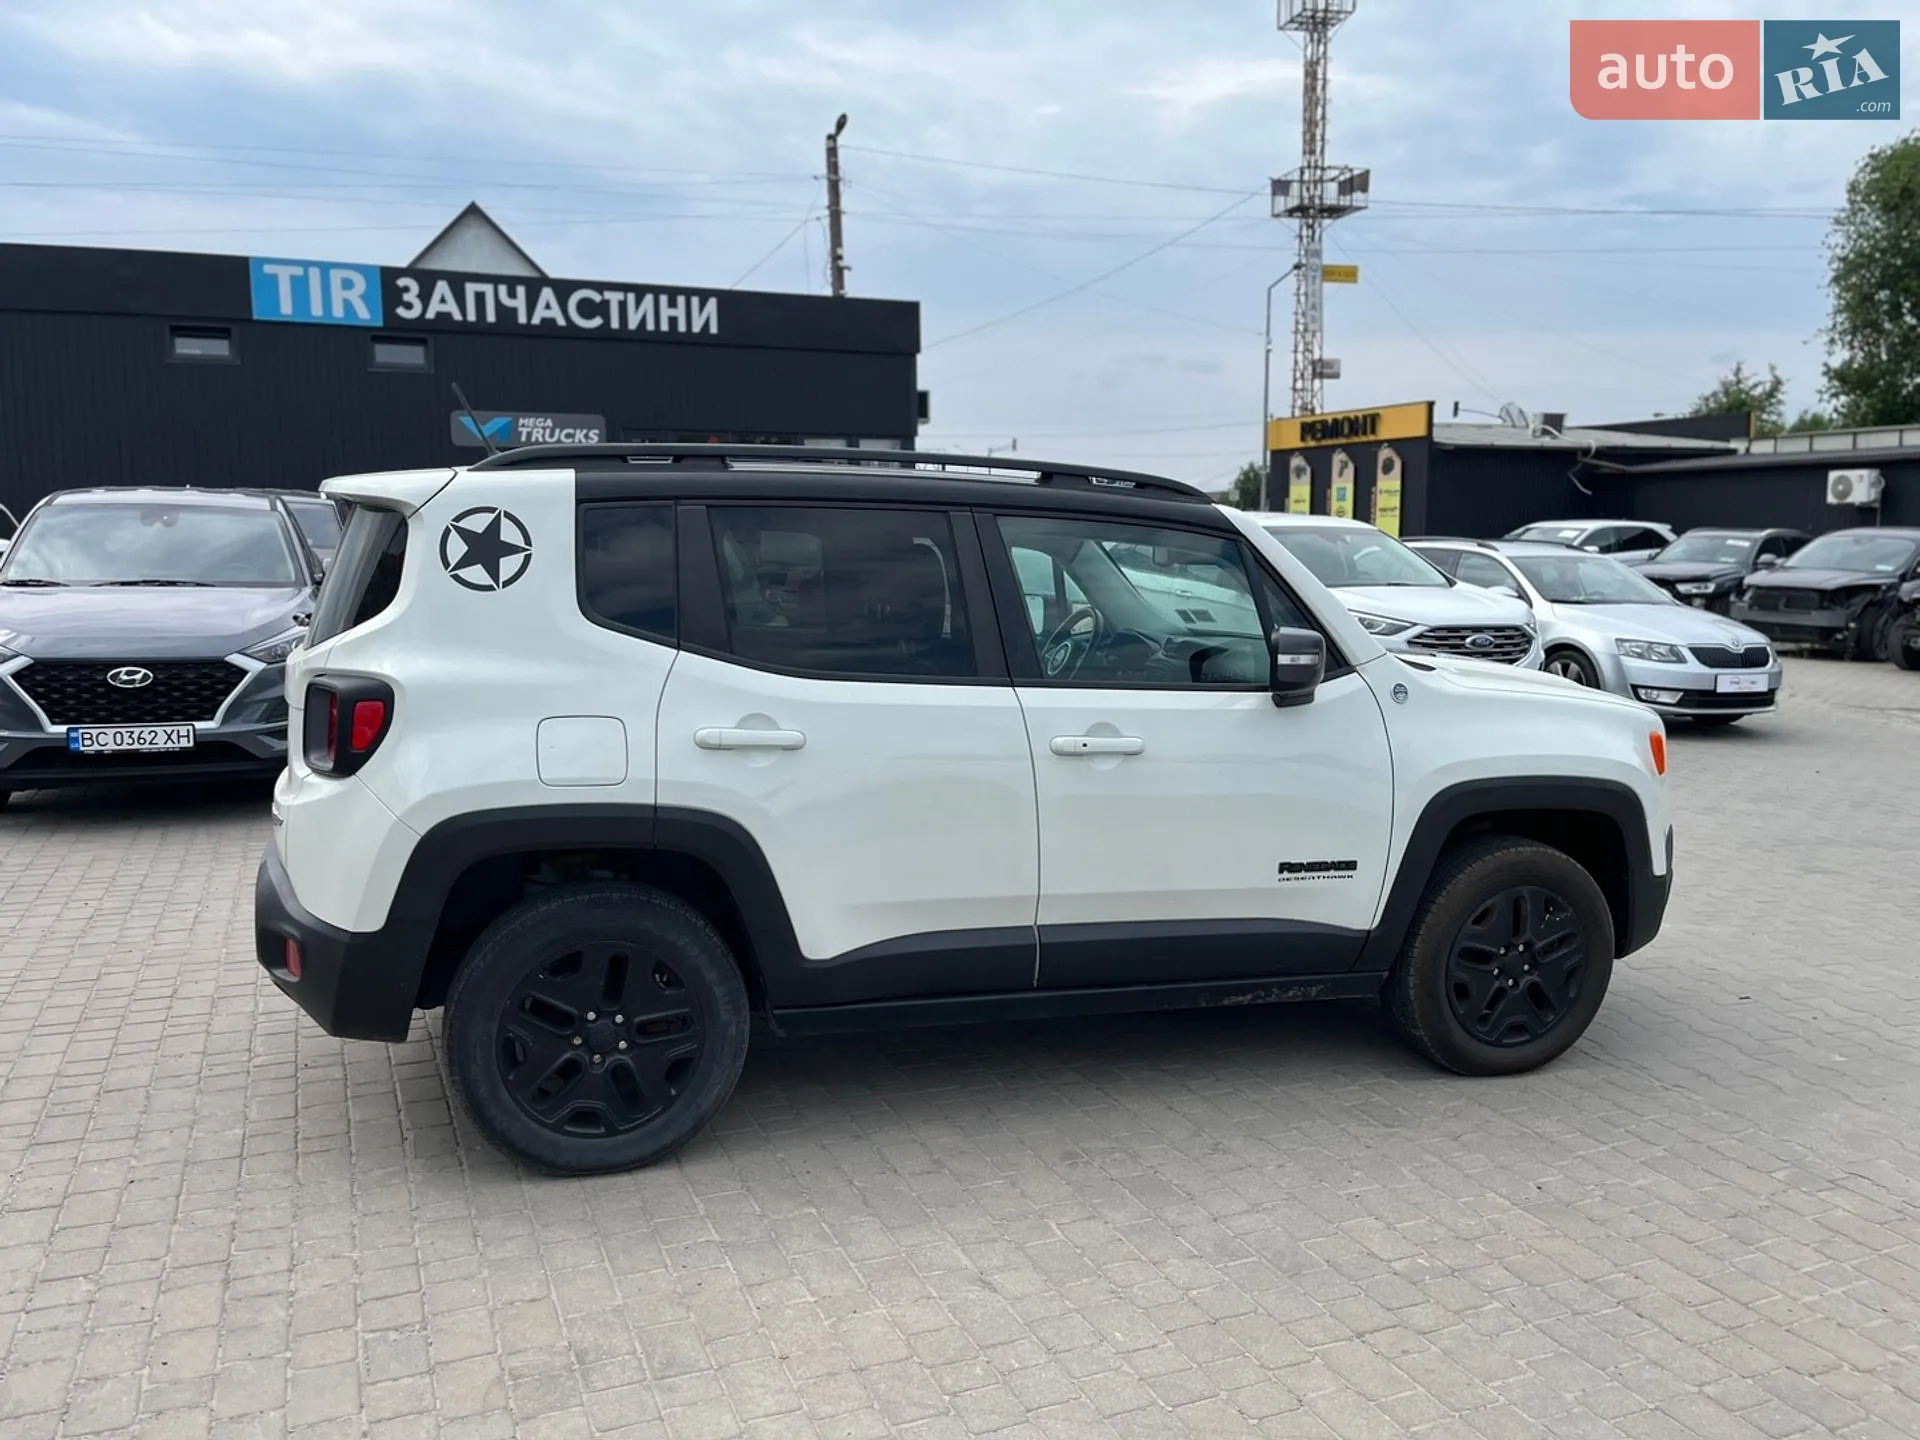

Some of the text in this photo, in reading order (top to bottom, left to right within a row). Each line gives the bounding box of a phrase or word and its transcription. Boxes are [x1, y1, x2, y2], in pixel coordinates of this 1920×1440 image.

[263, 263, 371, 320] TIR
[394, 276, 719, 335] ЗАПЧАСТИНИ
[518, 417, 553, 428] MEGA
[1300, 412, 1380, 442] РЕМОНТ
[518, 427, 600, 444] TRUCKS
[81, 731, 109, 748] BC
[113, 730, 159, 746] 0362
[163, 728, 191, 745] XH
